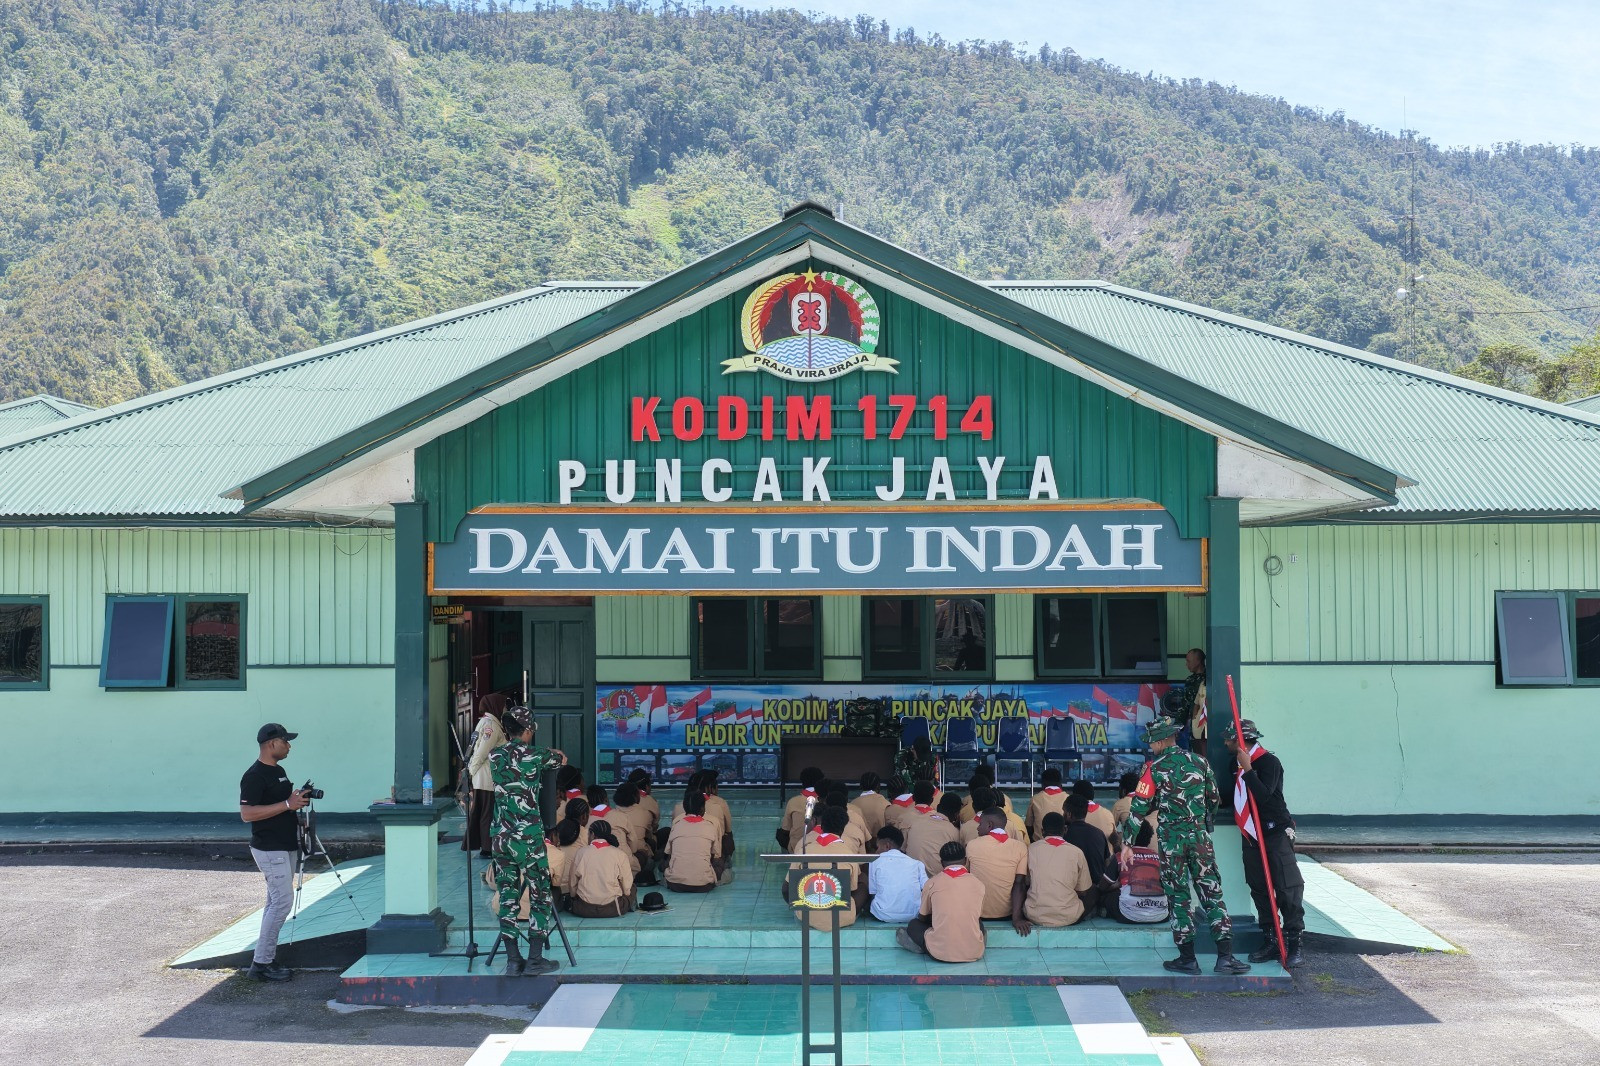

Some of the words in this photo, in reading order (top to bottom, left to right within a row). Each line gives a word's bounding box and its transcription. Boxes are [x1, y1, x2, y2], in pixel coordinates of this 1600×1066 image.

[753, 356, 793, 376] PRAJA
[796, 369, 825, 378] VIRA
[829, 354, 870, 375] BRAJA
[631, 395, 833, 441] KODIM
[858, 395, 994, 440] 1714
[558, 458, 832, 504] PUNCAK
[875, 456, 1059, 501] JAYA
[468, 527, 736, 574] DAMAI
[752, 526, 889, 574] ITU
[905, 524, 1163, 573] INDAH
[433, 605, 463, 615] DANDIM
[763, 699, 828, 720] KODIM
[891, 700, 974, 721] PUNCAK
[979, 700, 1029, 720] JAYA
[685, 724, 748, 745] HADIR
